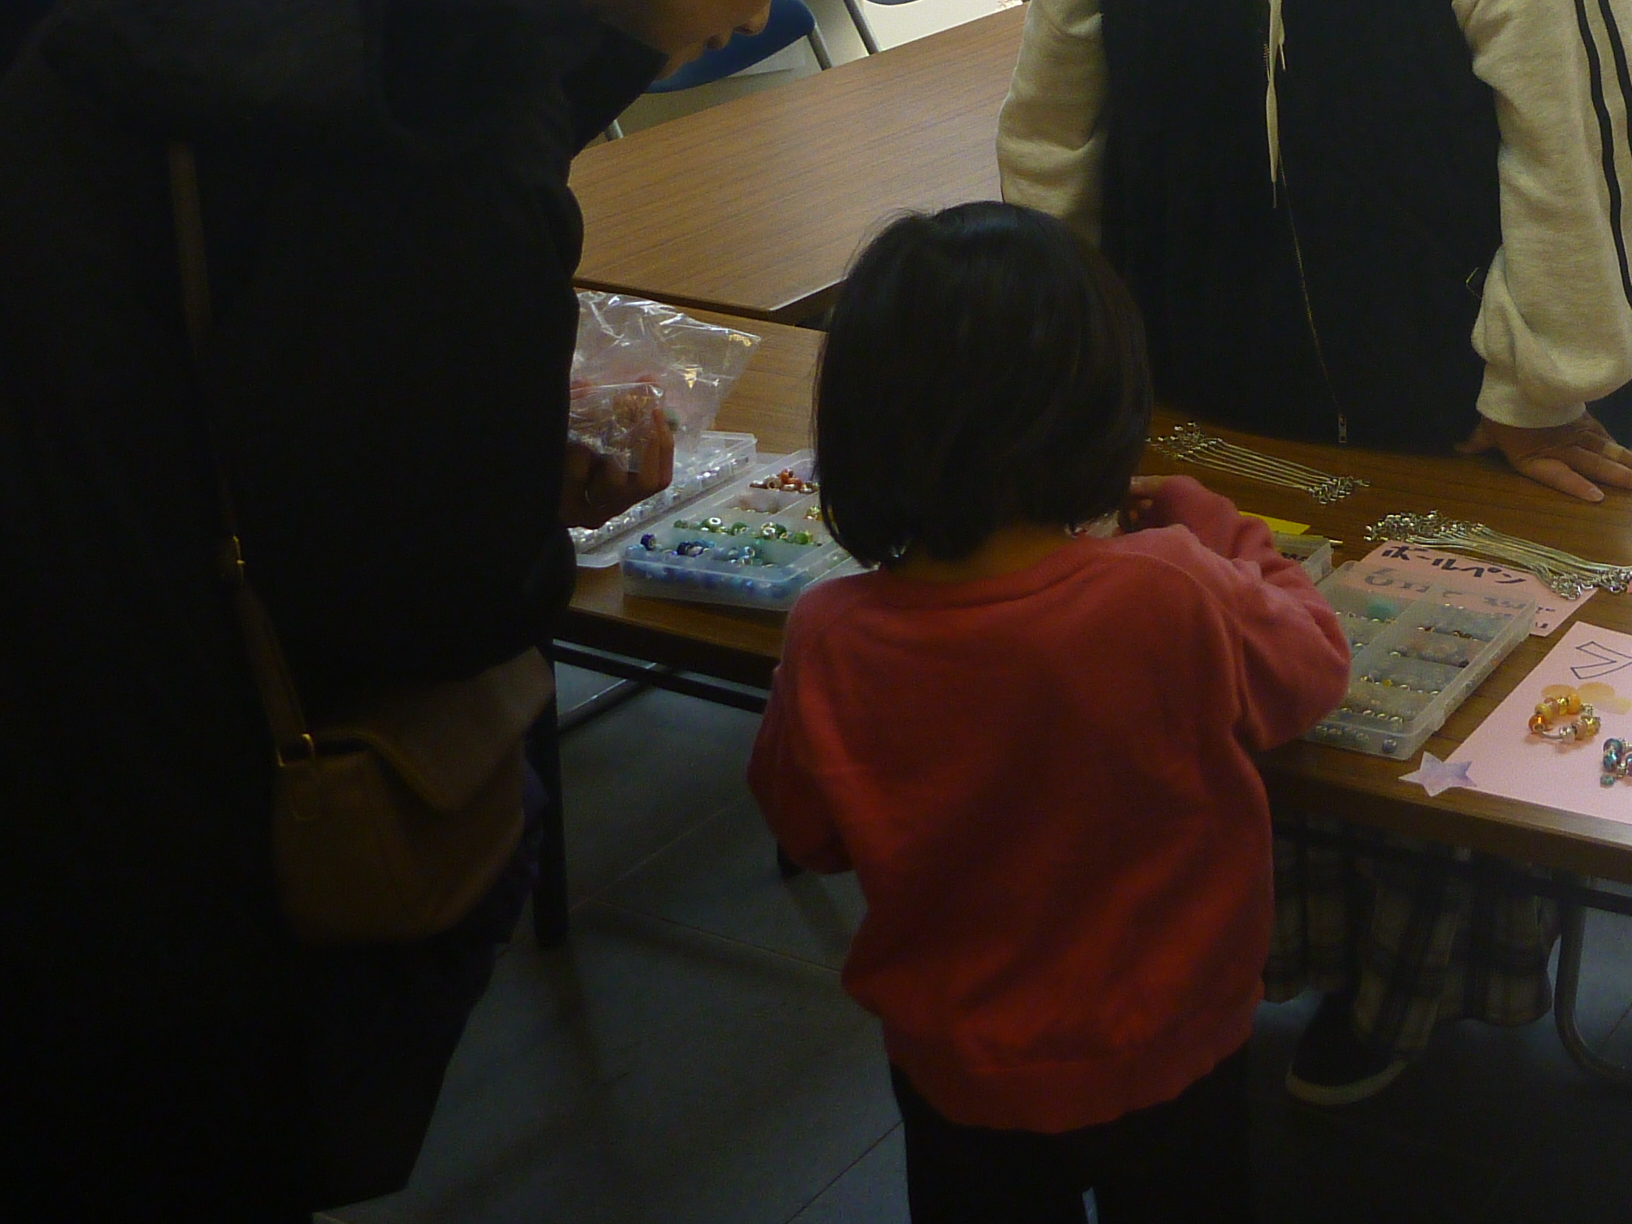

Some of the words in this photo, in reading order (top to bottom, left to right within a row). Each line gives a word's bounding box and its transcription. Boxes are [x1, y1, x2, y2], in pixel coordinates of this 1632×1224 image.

[1381, 545, 1527, 585] ボールペン
